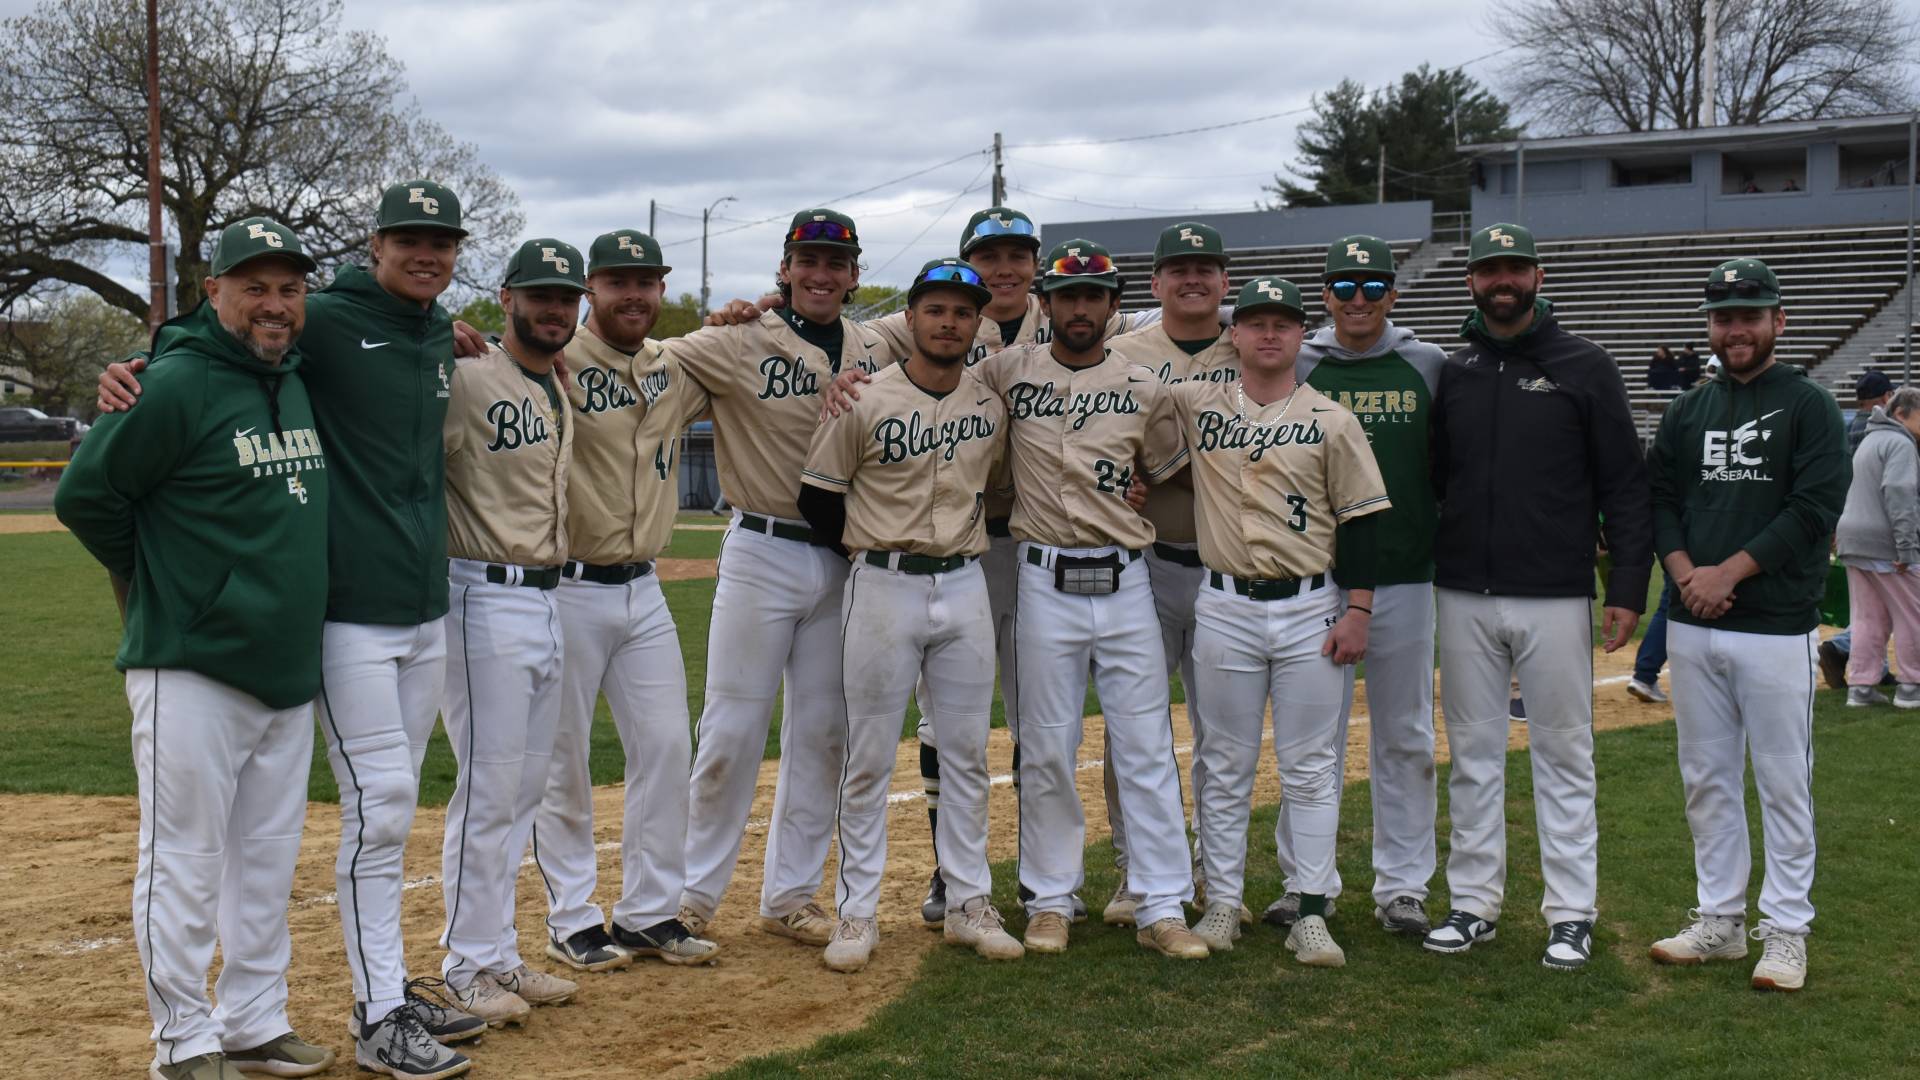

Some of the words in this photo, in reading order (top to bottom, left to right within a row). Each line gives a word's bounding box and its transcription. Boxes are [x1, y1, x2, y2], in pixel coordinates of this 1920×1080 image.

[408, 187, 439, 215] EC
[247, 223, 284, 248] EC
[617, 235, 645, 259] EC
[1180, 227, 1204, 248] EC
[1488, 228, 1516, 248] EC
[541, 247, 570, 274] EC
[1346, 242, 1370, 265] EC
[1724, 269, 1744, 283] E
[1257, 280, 1283, 301] EC
[1008, 381, 1139, 431] Blazers
[874, 409, 996, 465] Blazers
[1197, 409, 1326, 463] Blazers
[1094, 458, 1132, 500] 24
[1286, 493, 1308, 533] 3
